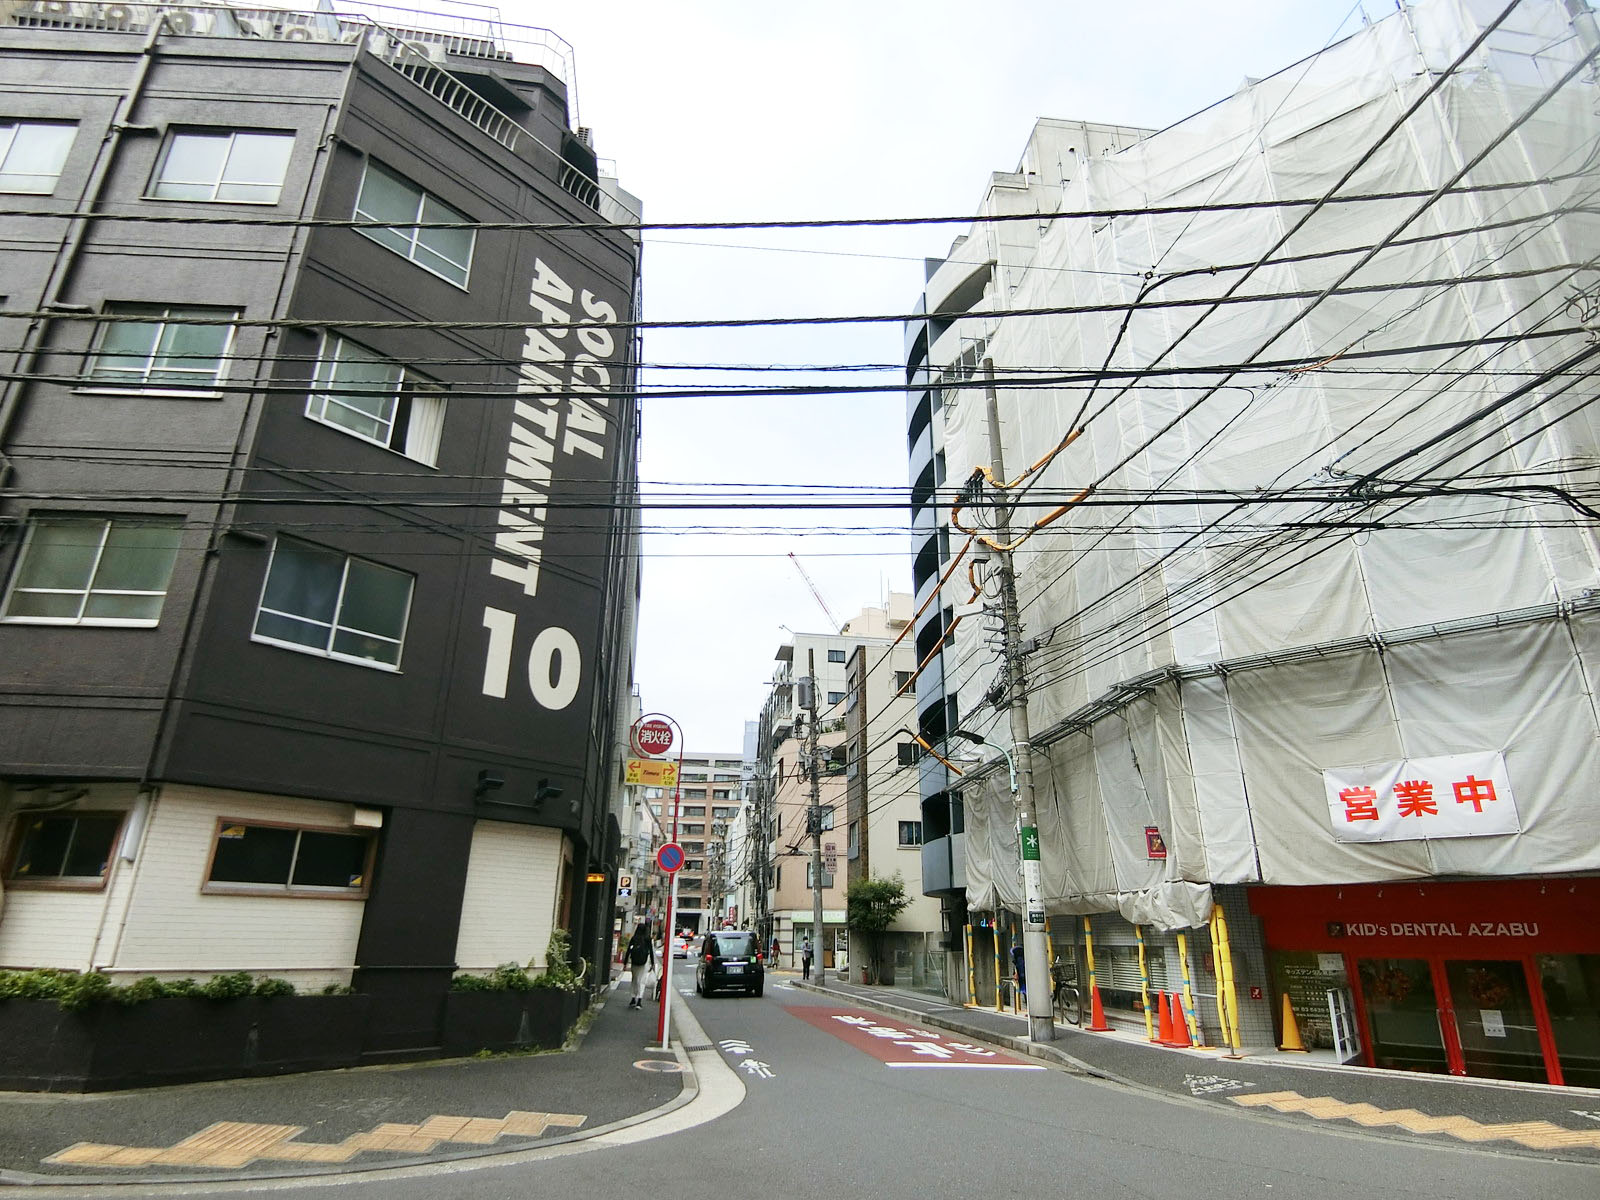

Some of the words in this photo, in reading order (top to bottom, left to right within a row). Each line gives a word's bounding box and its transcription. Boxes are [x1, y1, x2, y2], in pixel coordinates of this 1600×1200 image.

[563, 289, 617, 459] SOCIAL
[490, 257, 574, 597] APARTMENT
[481, 606, 582, 711] 10
[640, 729, 672, 745] 消火栓
[1338, 774, 1498, 823] 営業中
[1346, 923, 1388, 936] KID's
[1390, 923, 1462, 936] DENTAL
[1467, 922, 1539, 937] AZABU
